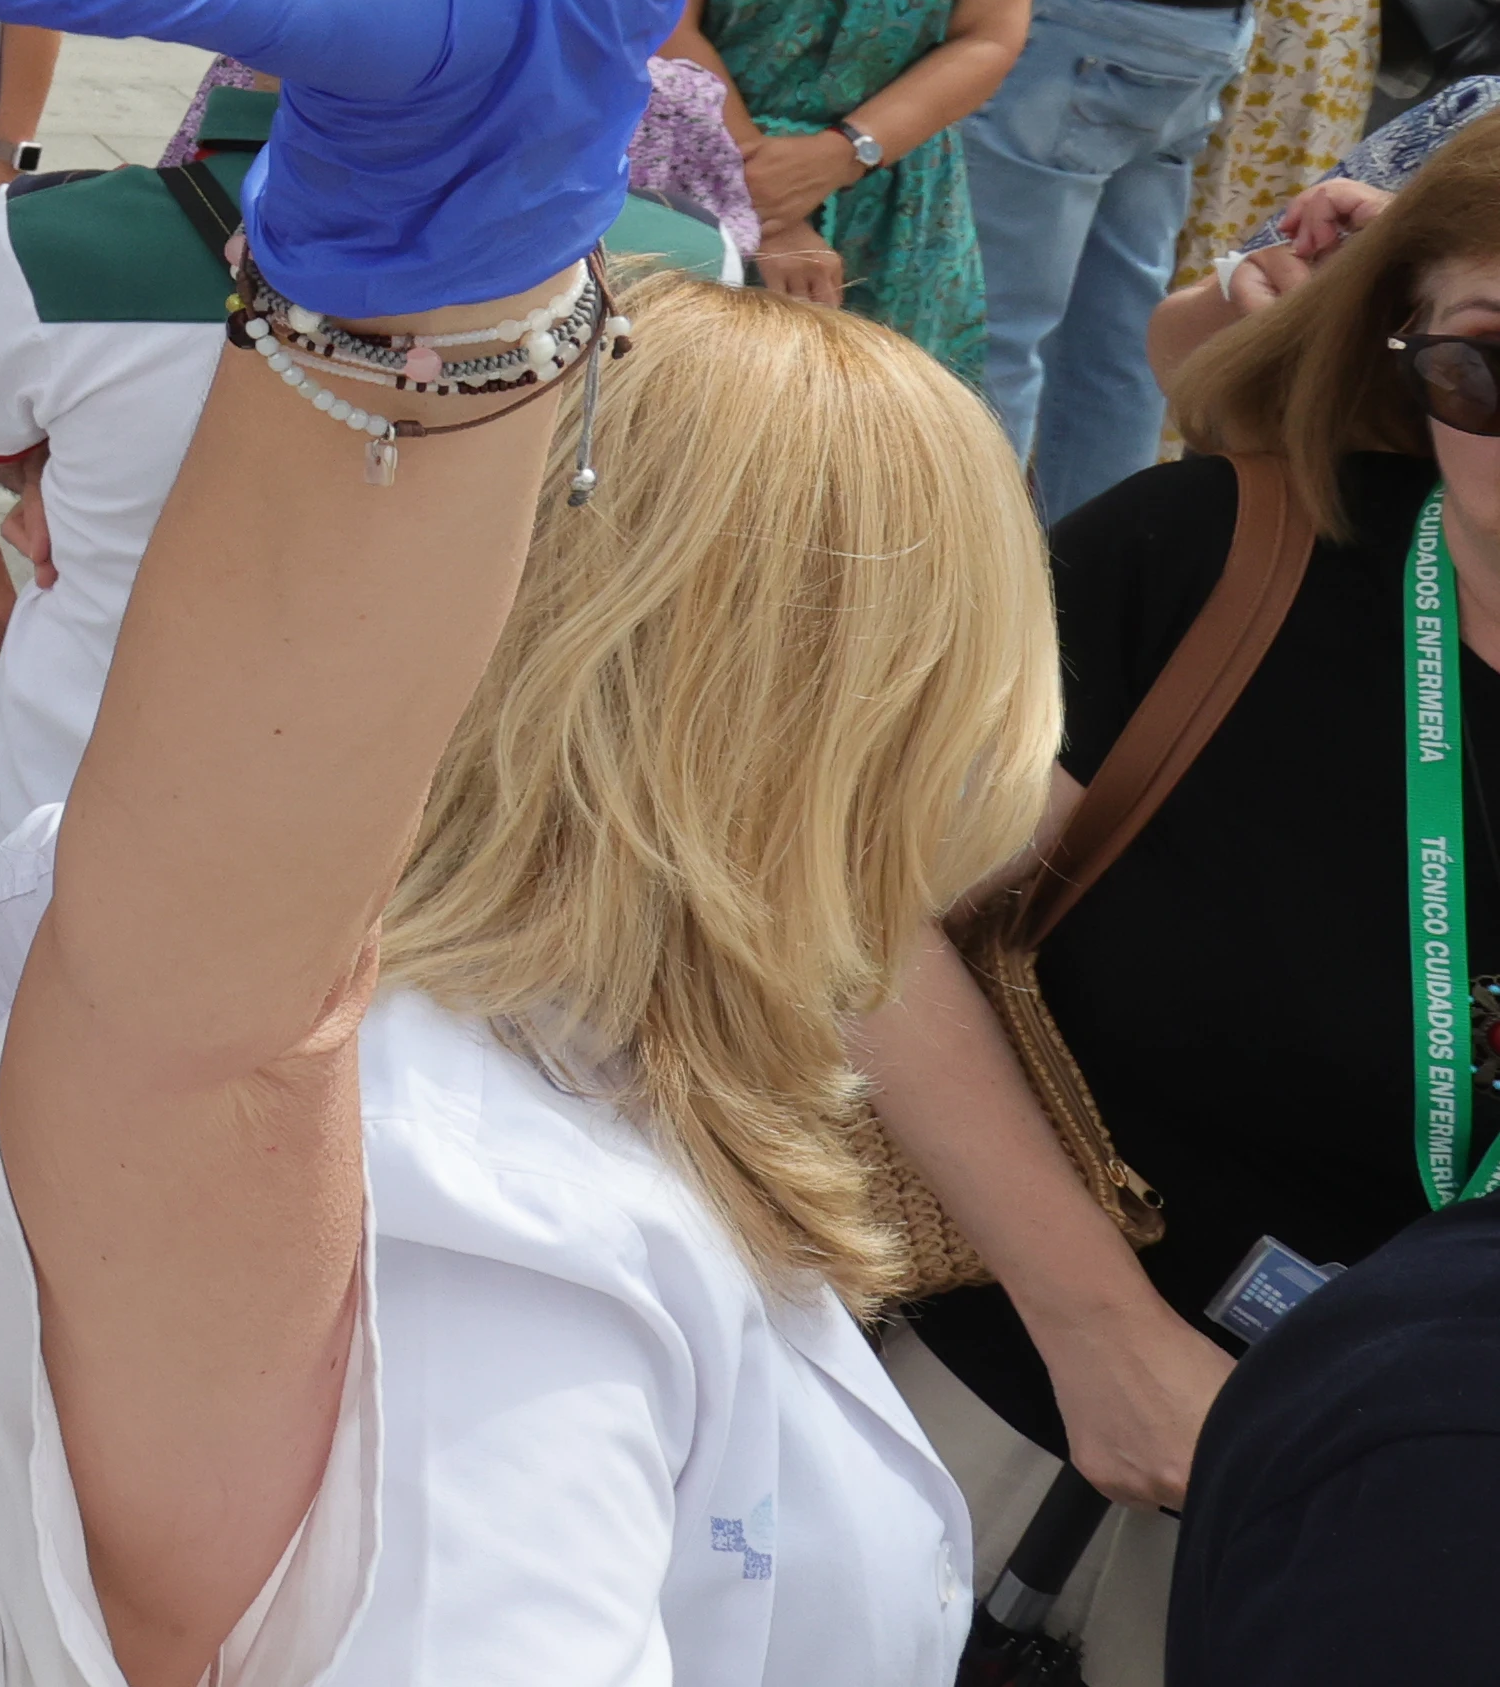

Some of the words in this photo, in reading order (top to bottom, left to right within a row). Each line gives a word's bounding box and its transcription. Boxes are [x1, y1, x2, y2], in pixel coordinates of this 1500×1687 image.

[1415, 502, 1443, 610] CUIDADOS
[1415, 616, 1452, 763] ENFERMERÍA
[1419, 836, 1454, 937] TÉCNICO
[1423, 940, 1452, 1061] CUIDADOS
[1427, 1064, 1459, 1208] ENFERMERÍA
